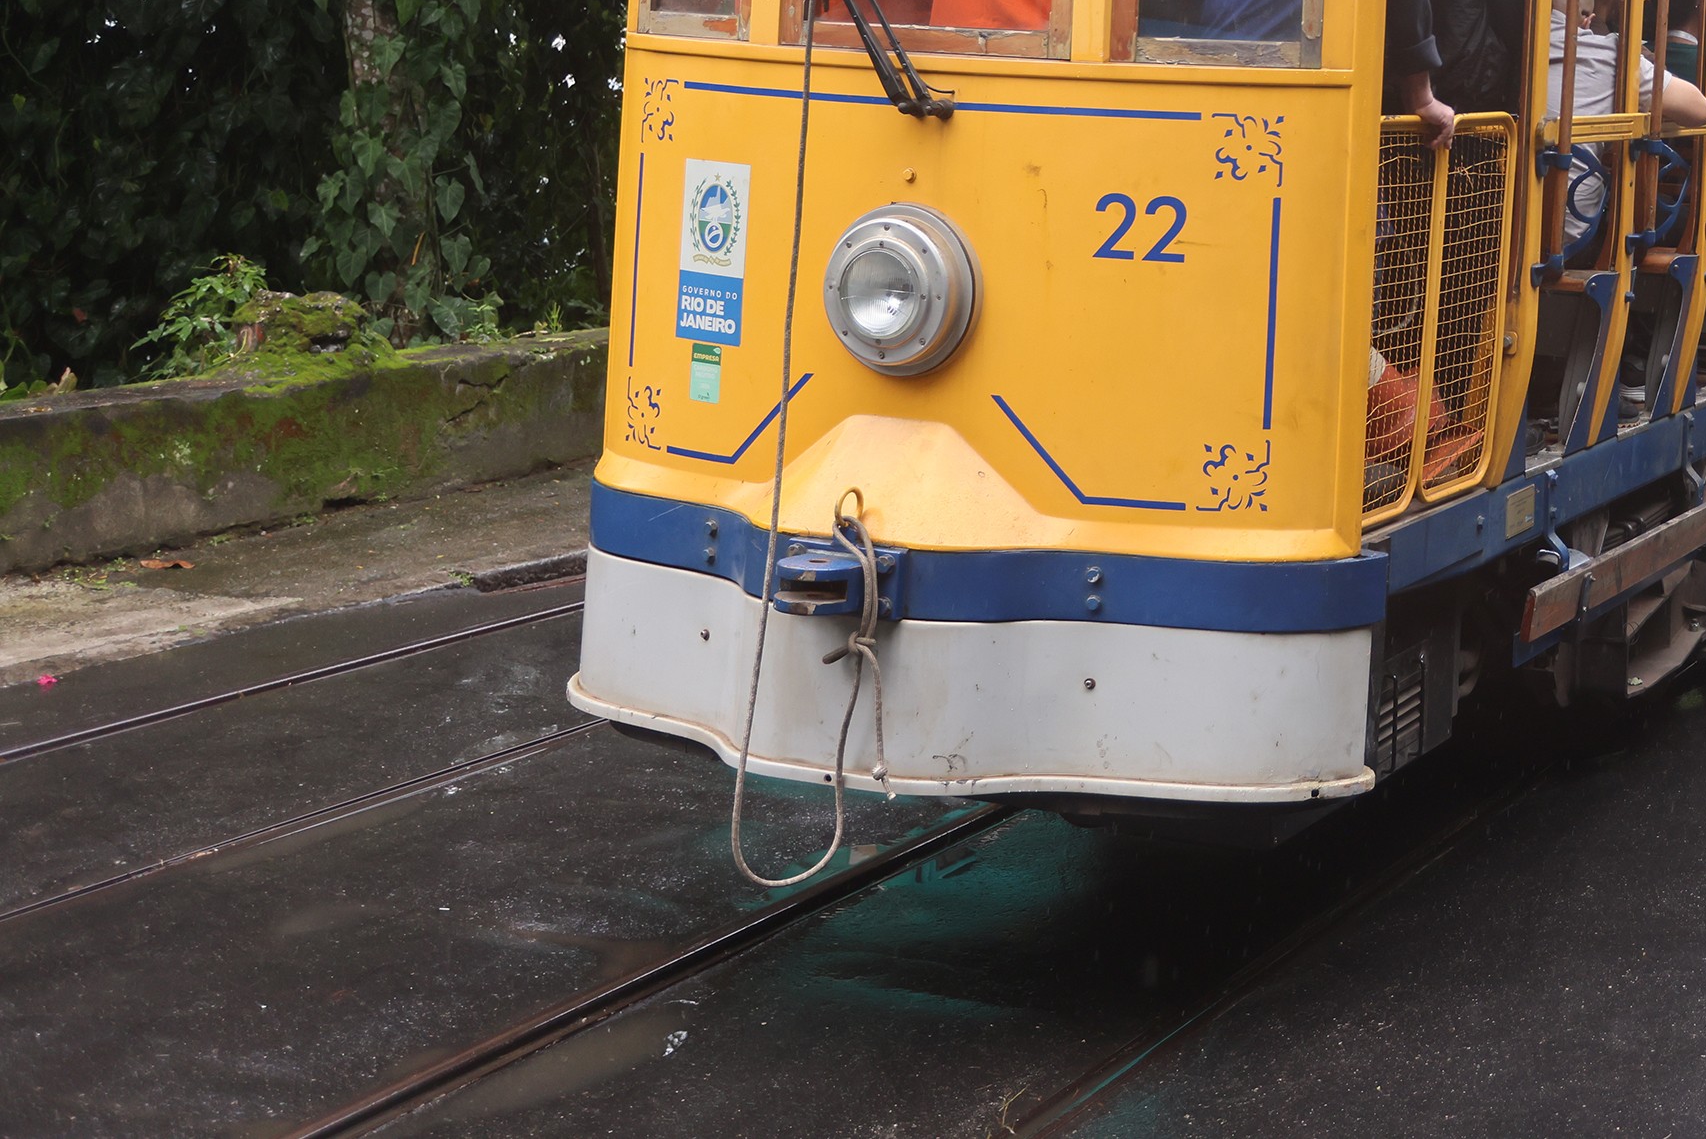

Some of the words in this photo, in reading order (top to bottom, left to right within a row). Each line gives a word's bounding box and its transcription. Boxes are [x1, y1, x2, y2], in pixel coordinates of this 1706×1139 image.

[1092, 193, 1187, 263] 22
[682, 285, 722, 299] GOVERNO
[725, 292, 738, 301] DO
[681, 295, 705, 312] RIO
[706, 299, 725, 316] DE
[680, 313, 736, 334] JANEIRO
